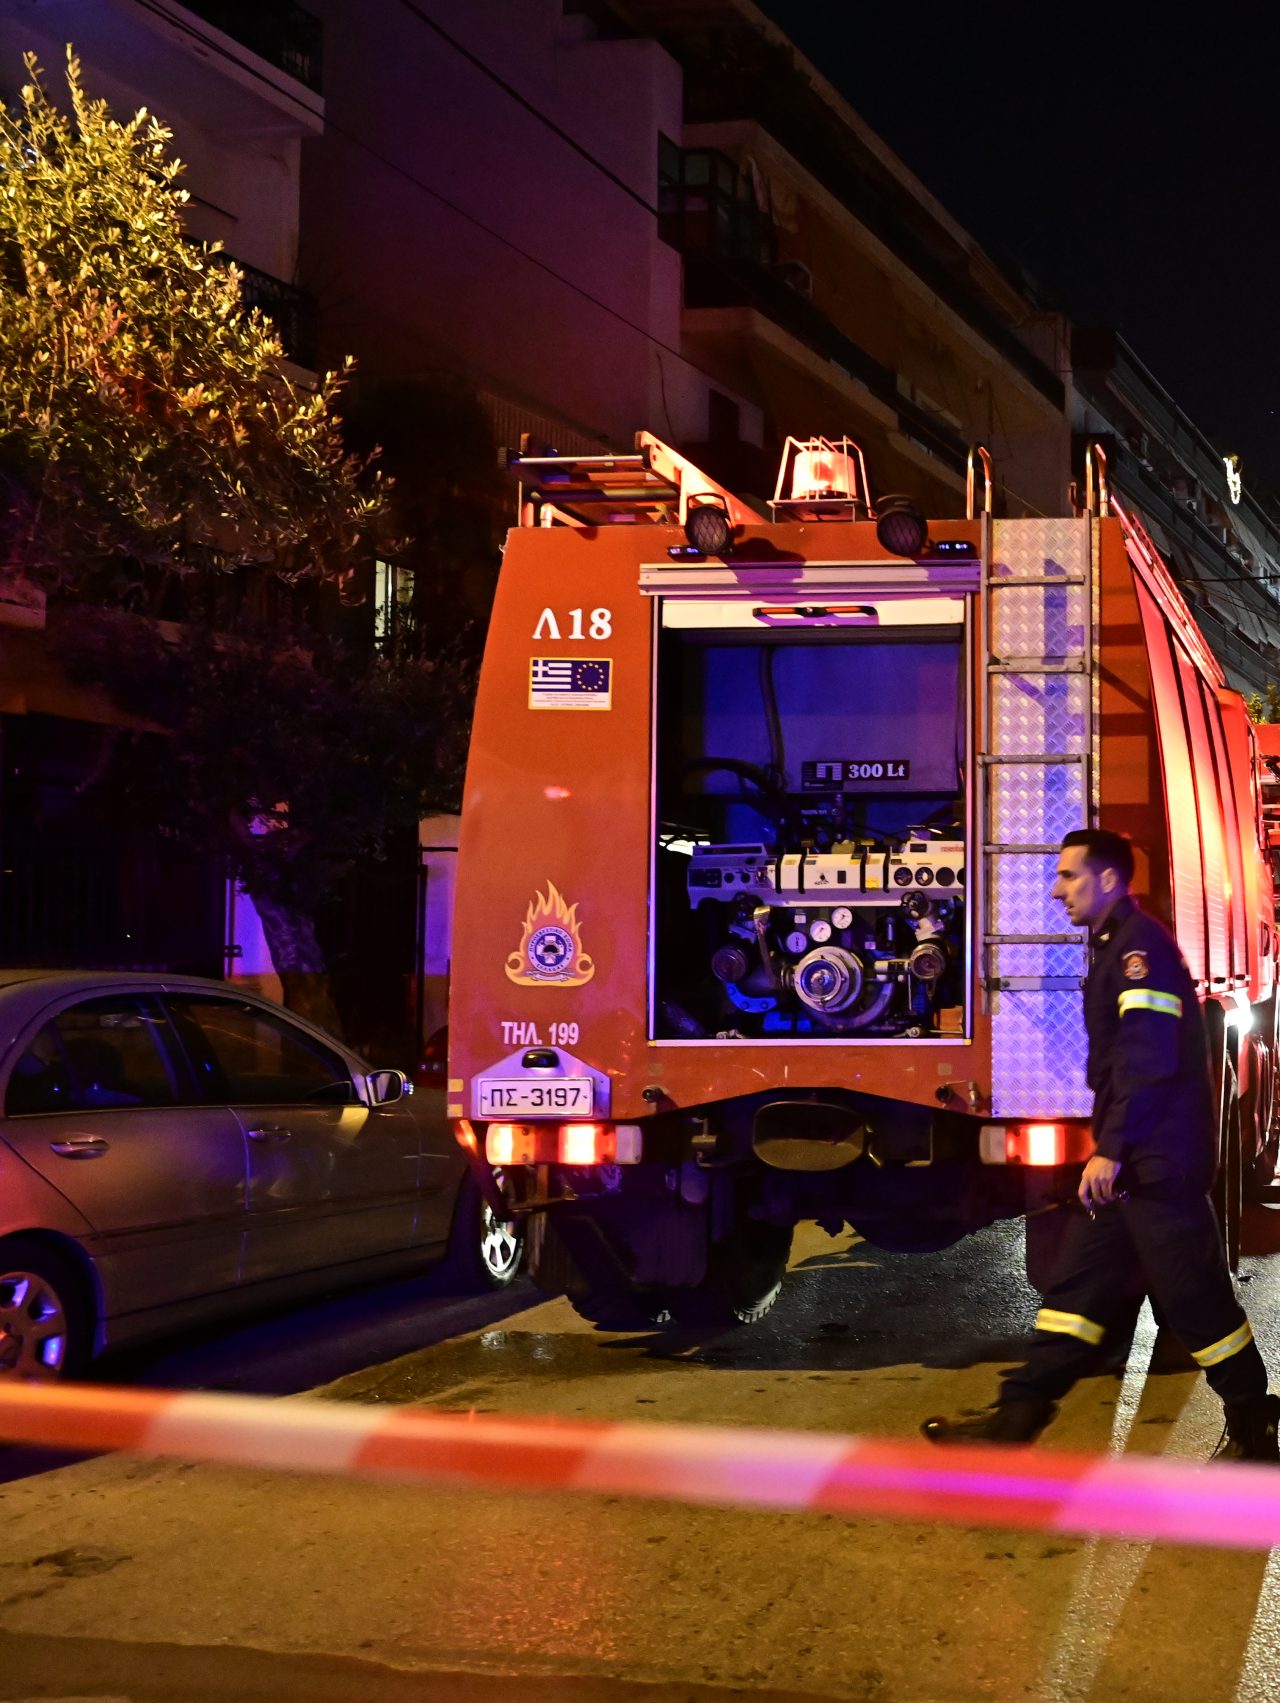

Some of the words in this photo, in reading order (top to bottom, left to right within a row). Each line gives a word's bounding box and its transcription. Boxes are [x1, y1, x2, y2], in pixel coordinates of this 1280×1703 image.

[848, 763, 883, 778] 300
[887, 763, 905, 777] Lt
[501, 1021, 542, 1045] ΤΗΛ.
[549, 1022, 579, 1045] 199
[490, 1087, 581, 1107] ΠΣ-3197
